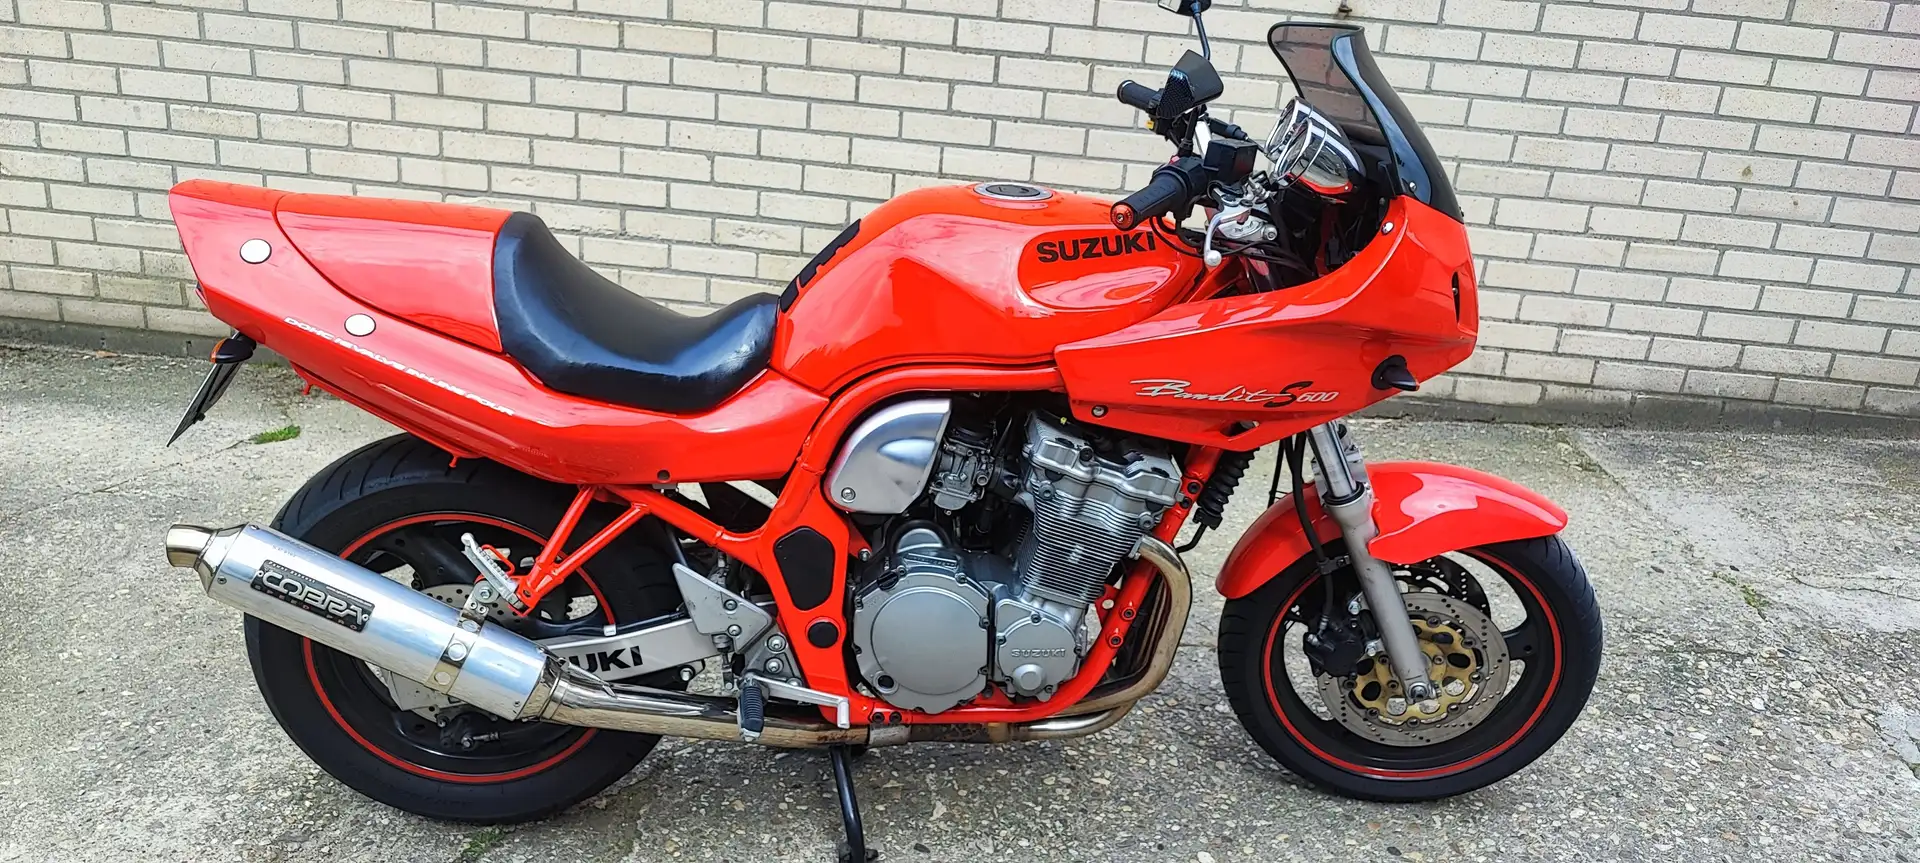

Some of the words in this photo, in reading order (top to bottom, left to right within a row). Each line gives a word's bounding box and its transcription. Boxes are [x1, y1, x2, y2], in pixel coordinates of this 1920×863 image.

[1036, 231, 1156, 263] SUZUKI
[284, 316, 335, 341] DOHC
[466, 393, 516, 416] FOUR
[1130, 379, 1291, 402] Bandit
[262, 571, 363, 625] COBRA
[1011, 648, 1066, 658] SUZUKI
